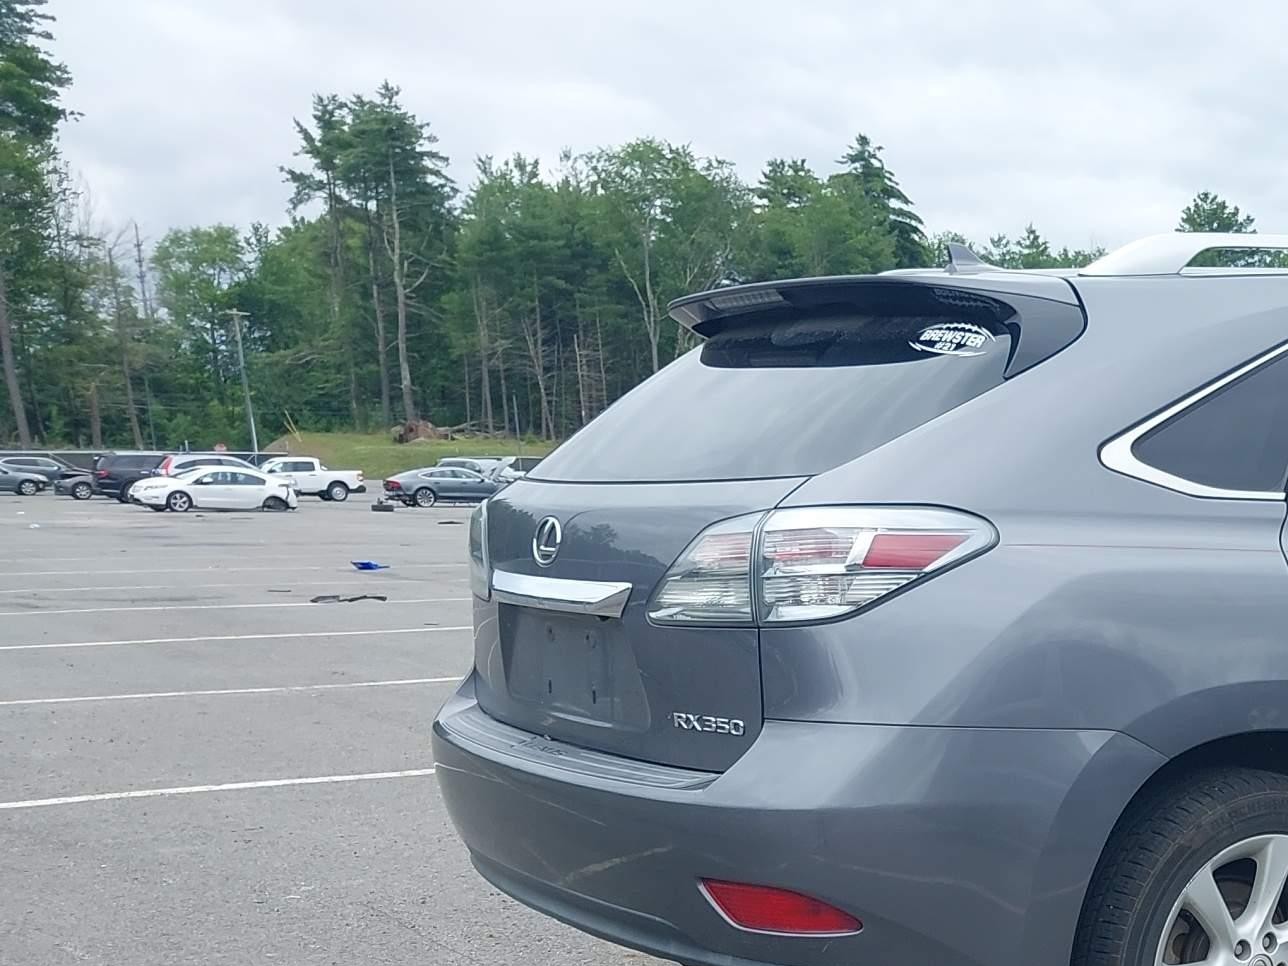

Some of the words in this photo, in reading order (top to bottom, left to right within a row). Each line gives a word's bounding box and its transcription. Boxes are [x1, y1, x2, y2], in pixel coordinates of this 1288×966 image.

[919, 329, 987, 349] BREWSTER
[934, 341, 957, 352] #21
[672, 711, 746, 737] RX350
